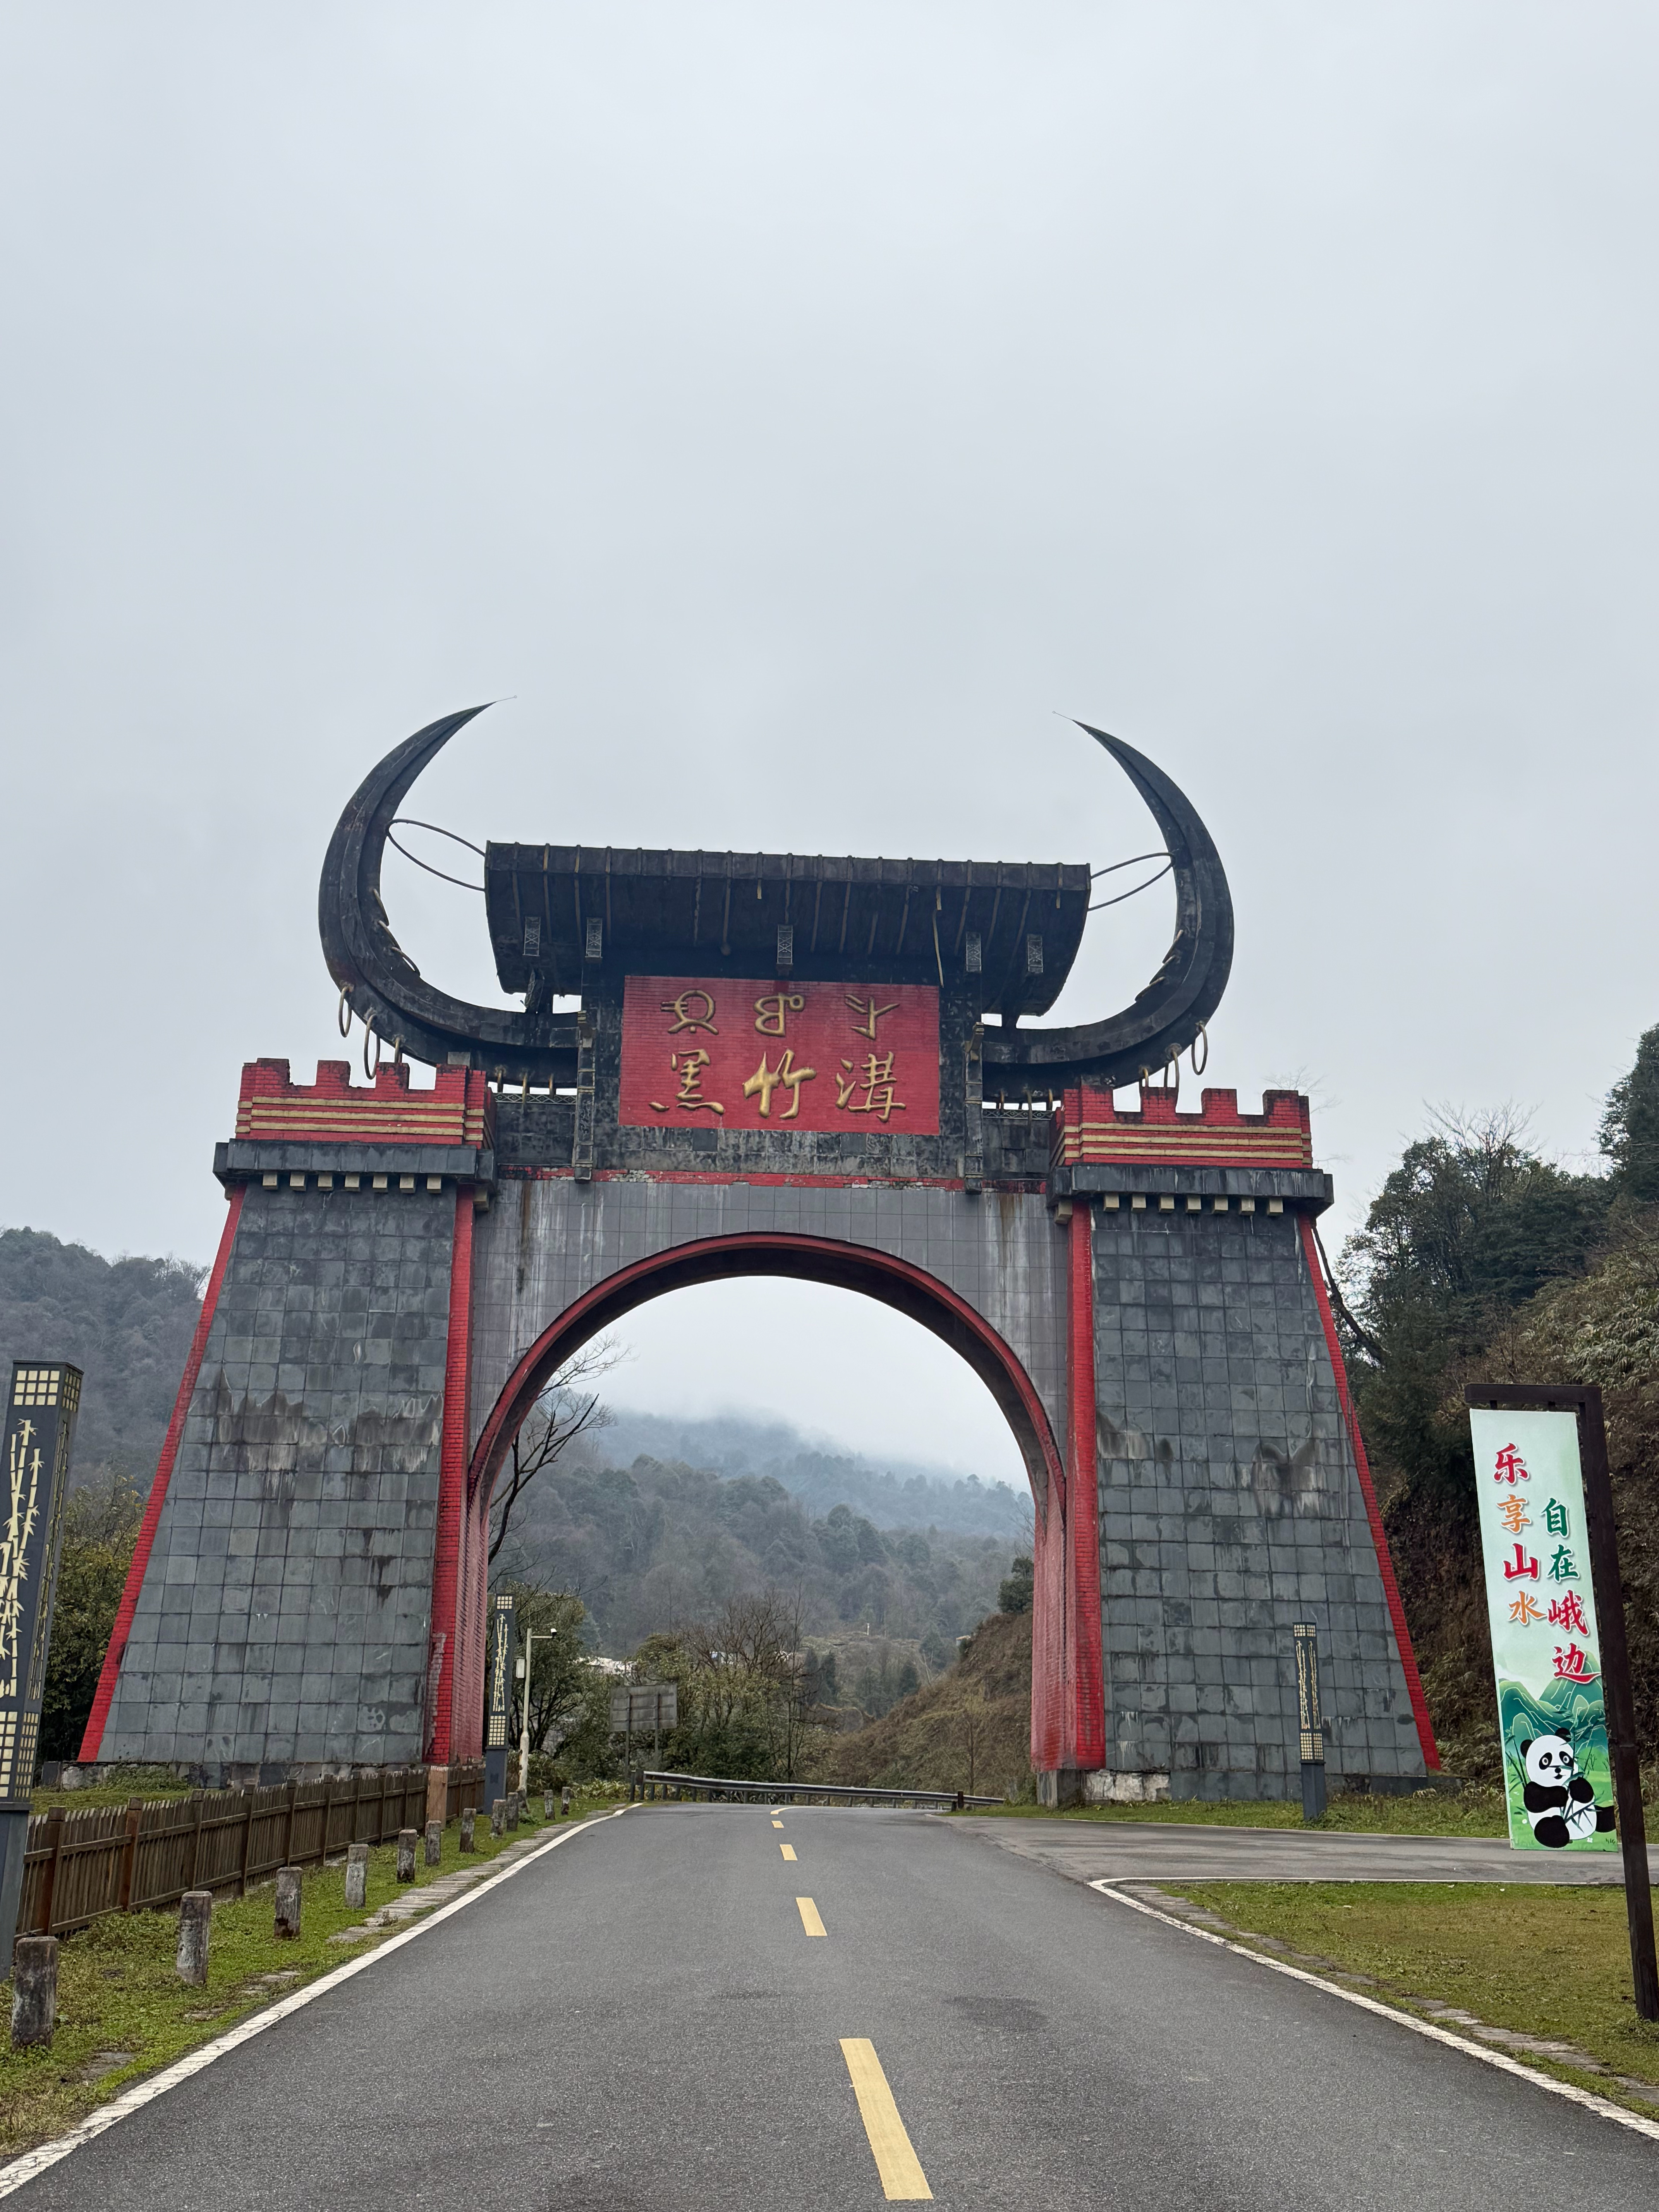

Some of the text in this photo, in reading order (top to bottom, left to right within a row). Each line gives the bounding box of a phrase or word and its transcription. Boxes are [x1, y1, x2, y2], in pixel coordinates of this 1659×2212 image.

[1494, 1443, 1546, 1624] 乐享山水
[1541, 1498, 1601, 1683] 自在峨边
